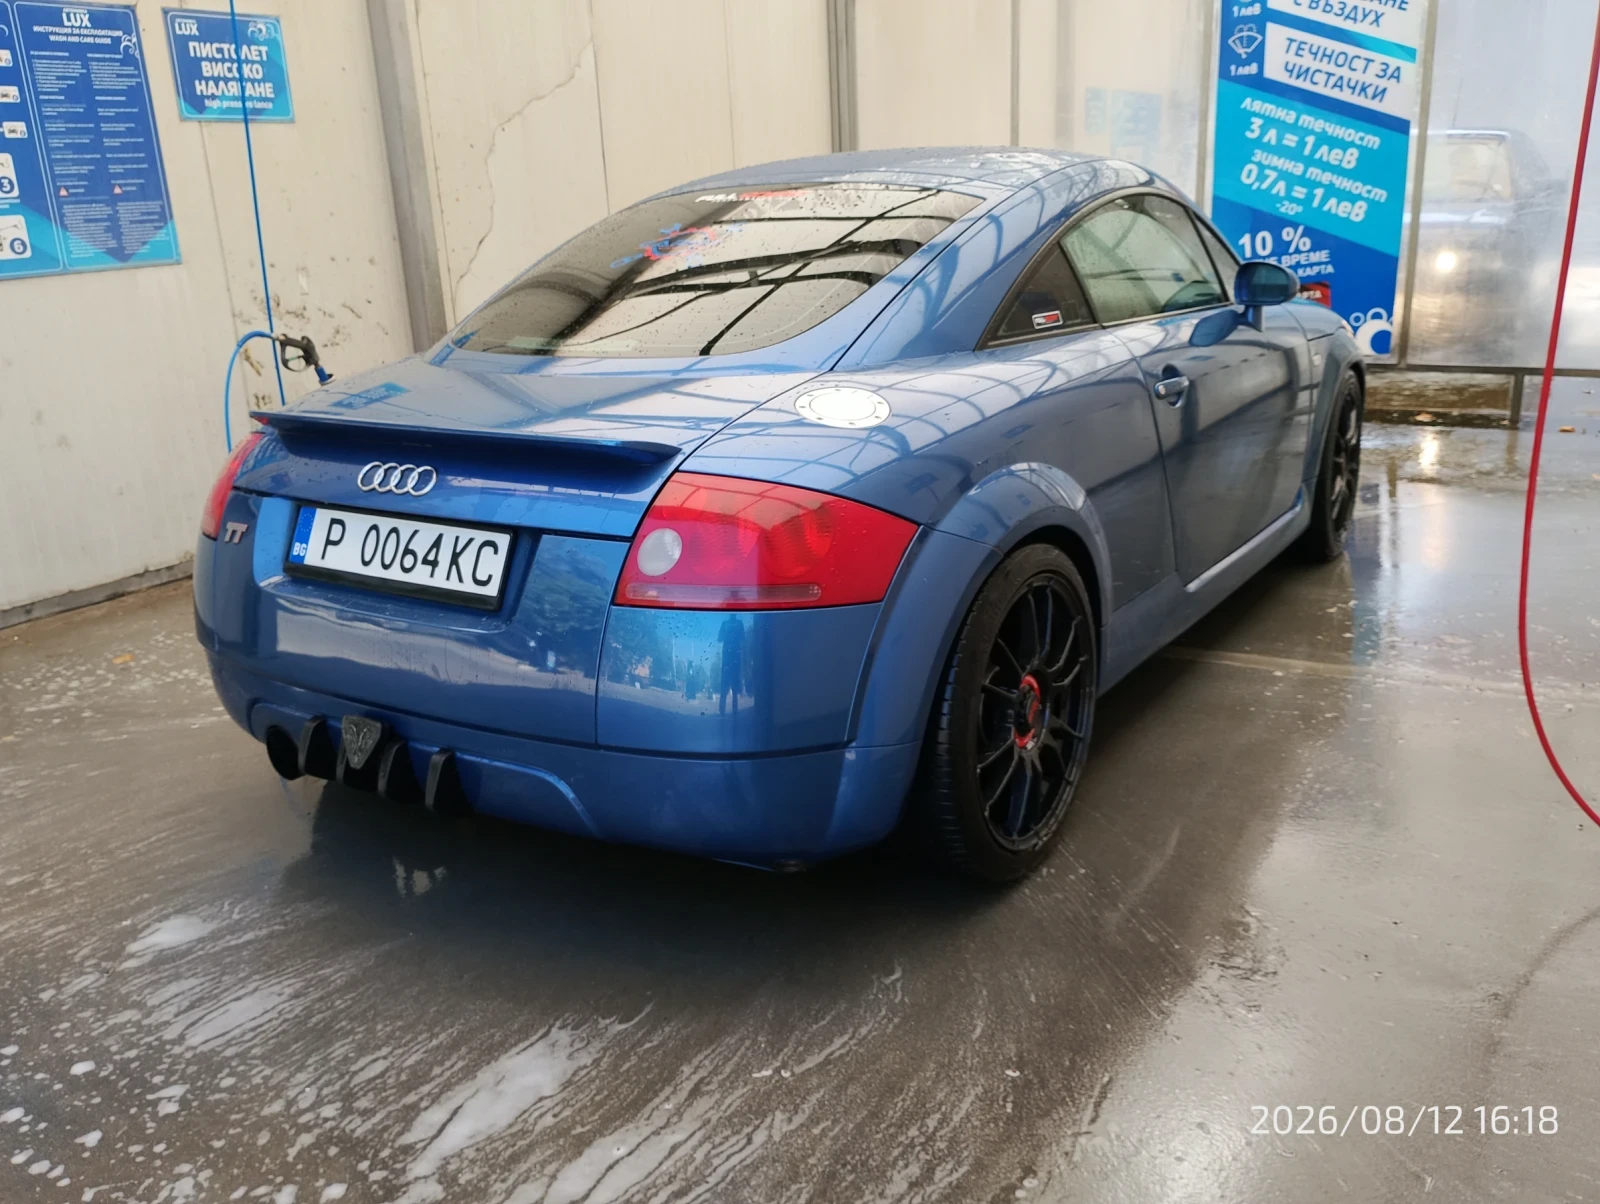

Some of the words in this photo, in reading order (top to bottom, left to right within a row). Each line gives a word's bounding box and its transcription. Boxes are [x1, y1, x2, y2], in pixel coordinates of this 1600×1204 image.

[62, 13, 91, 28] LUX
[1232, 5, 1239, 17] 1
[1308, 0, 1385, 27] ВЪЗДУХ
[174, 21, 199, 36] LUX
[68, 35, 79, 43] AND
[1230, 64, 1236, 76] 1
[1285, 37, 1375, 75] ТЕЧНОСТ
[1375, 63, 1402, 83] ЗА
[1284, 61, 1388, 103] ЧИСТАЧКИ
[1240, 96, 1297, 124] лятна
[1298, 114, 1381, 150] течност
[1245, 117, 1264, 139] 3
[1282, 132, 1299, 148] =
[1303, 135, 1316, 156] 1
[1314, 144, 1360, 170] лев
[0, 179, 10, 191] 3
[1251, 149, 1304, 176] зимна
[1305, 166, 1388, 203] течност
[1291, 185, 1308, 199] =
[1312, 187, 1325, 208] 1
[1322, 195, 1368, 222] лев
[14, 240, 24, 253] 6
[1238, 230, 1273, 258] 10
[1282, 225, 1311, 253] %
[1280, 250, 1331, 267] ВРЕМЕ
[1297, 264, 1335, 278] КАРТА
[223, 521, 249, 544] TT
[320, 517, 347, 561] P
[293, 542, 307, 556] BG
